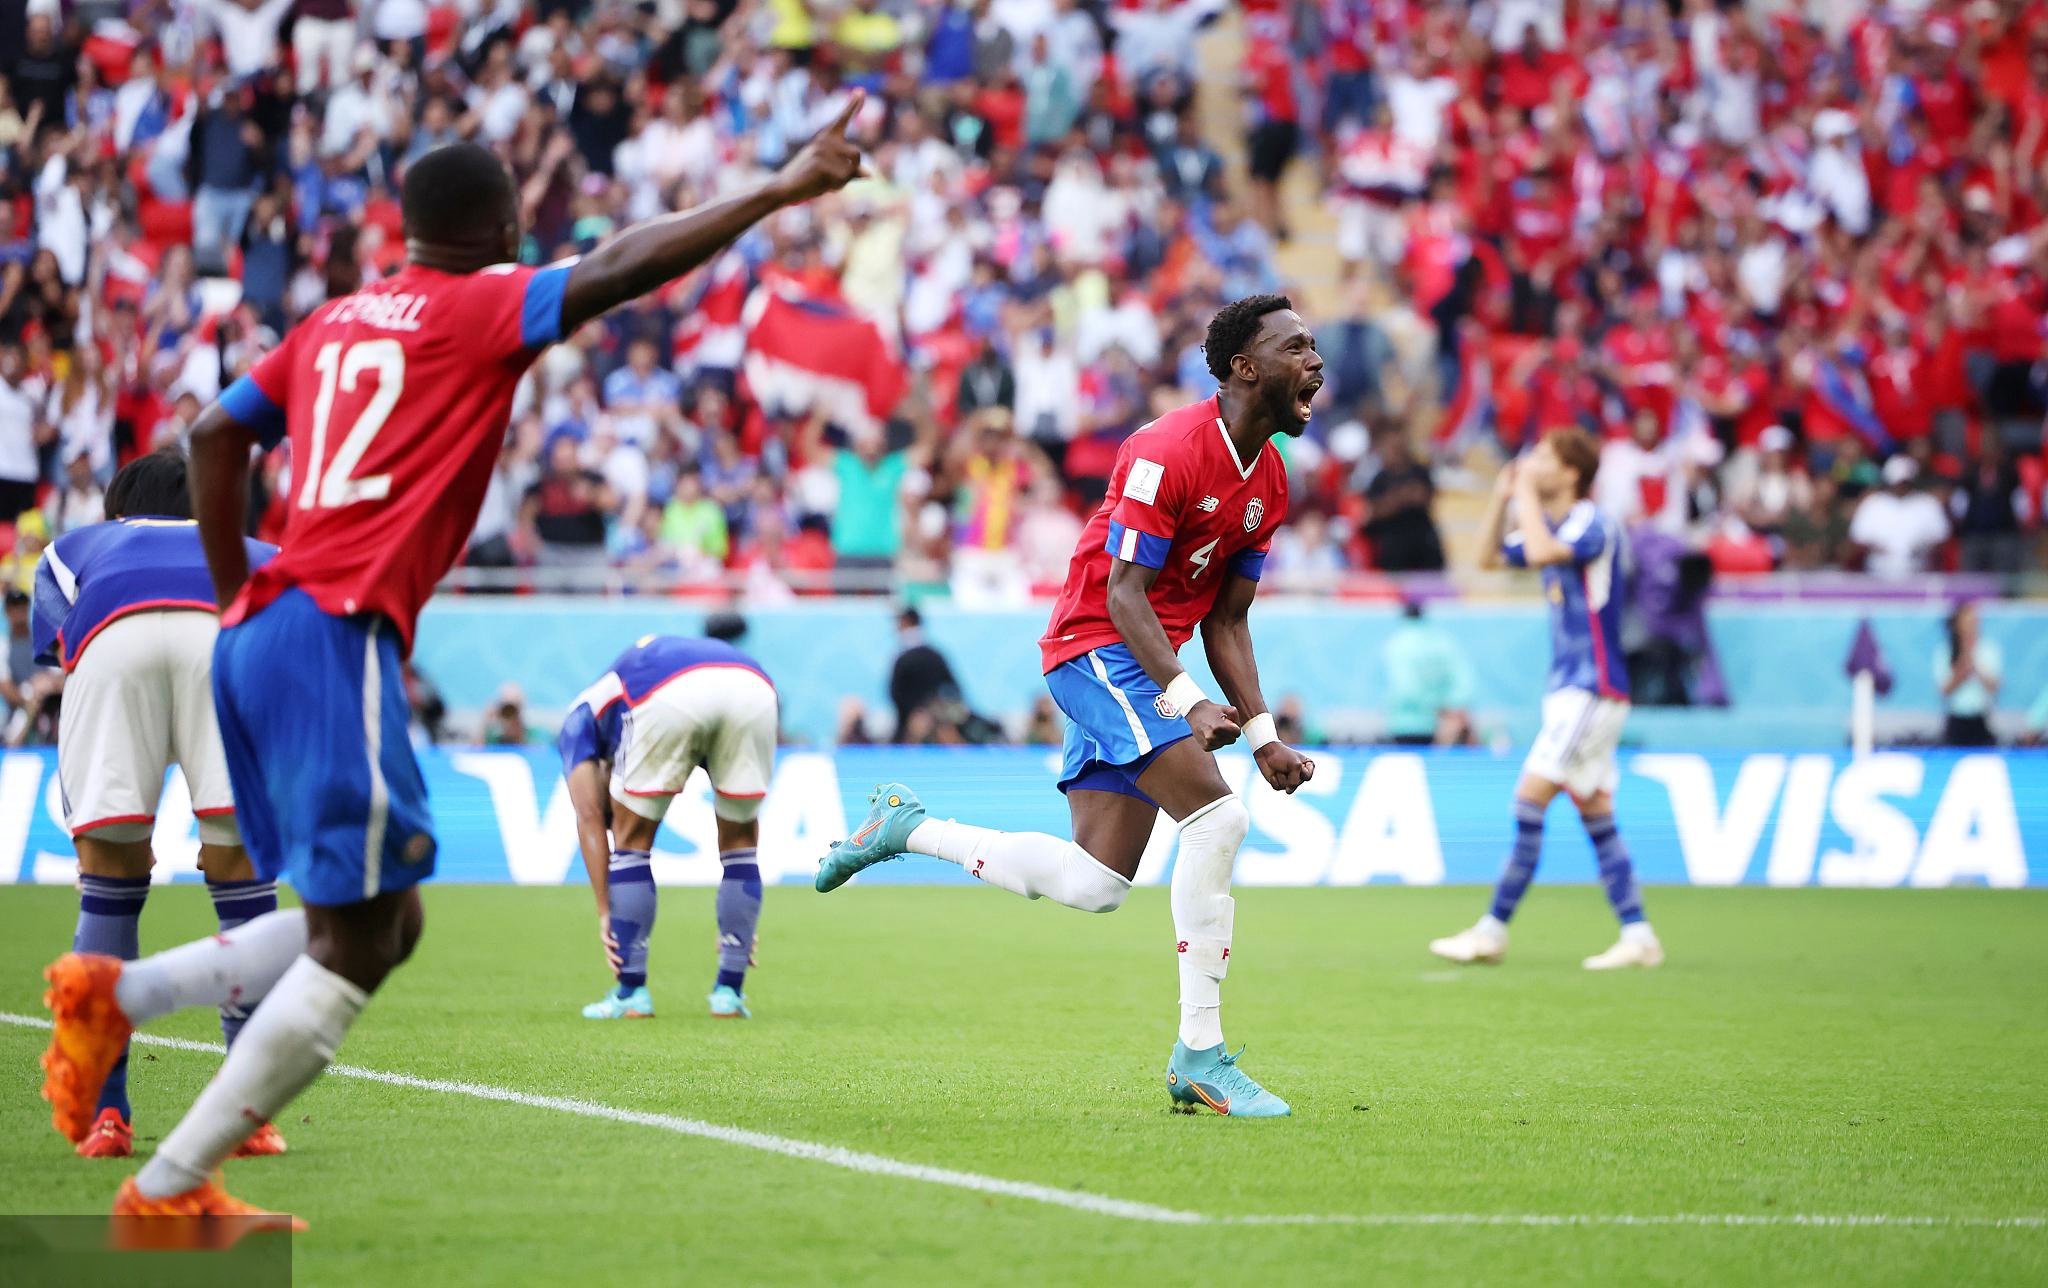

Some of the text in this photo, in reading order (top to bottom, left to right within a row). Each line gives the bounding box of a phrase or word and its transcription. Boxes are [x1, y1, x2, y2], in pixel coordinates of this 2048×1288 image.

[298, 338, 406, 511] 12
[1188, 536, 1221, 580] 4
[451, 752, 850, 886] VSA
[1631, 752, 2029, 888] VISA
